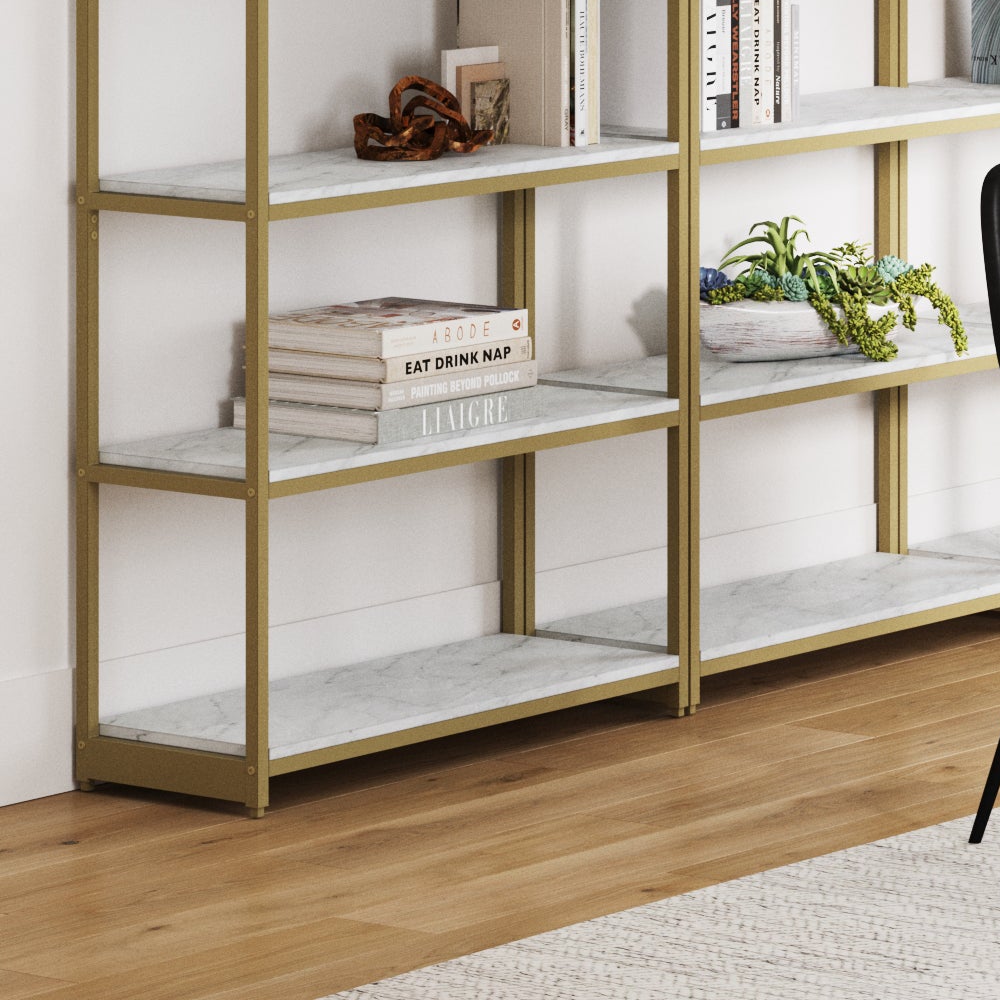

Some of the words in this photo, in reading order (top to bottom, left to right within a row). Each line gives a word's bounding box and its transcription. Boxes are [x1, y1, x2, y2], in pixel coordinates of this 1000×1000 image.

[432, 321, 490, 344] ABODE
[405, 358, 431, 375] EAT
[435, 351, 479, 370] DRINK
[483, 346, 511, 362] NAP
[410, 382, 448, 399] PAINTING
[449, 376, 482, 393] BEYOND
[483, 370, 520, 388] POLLOCK
[421, 395, 509, 436] LIAIGRE
